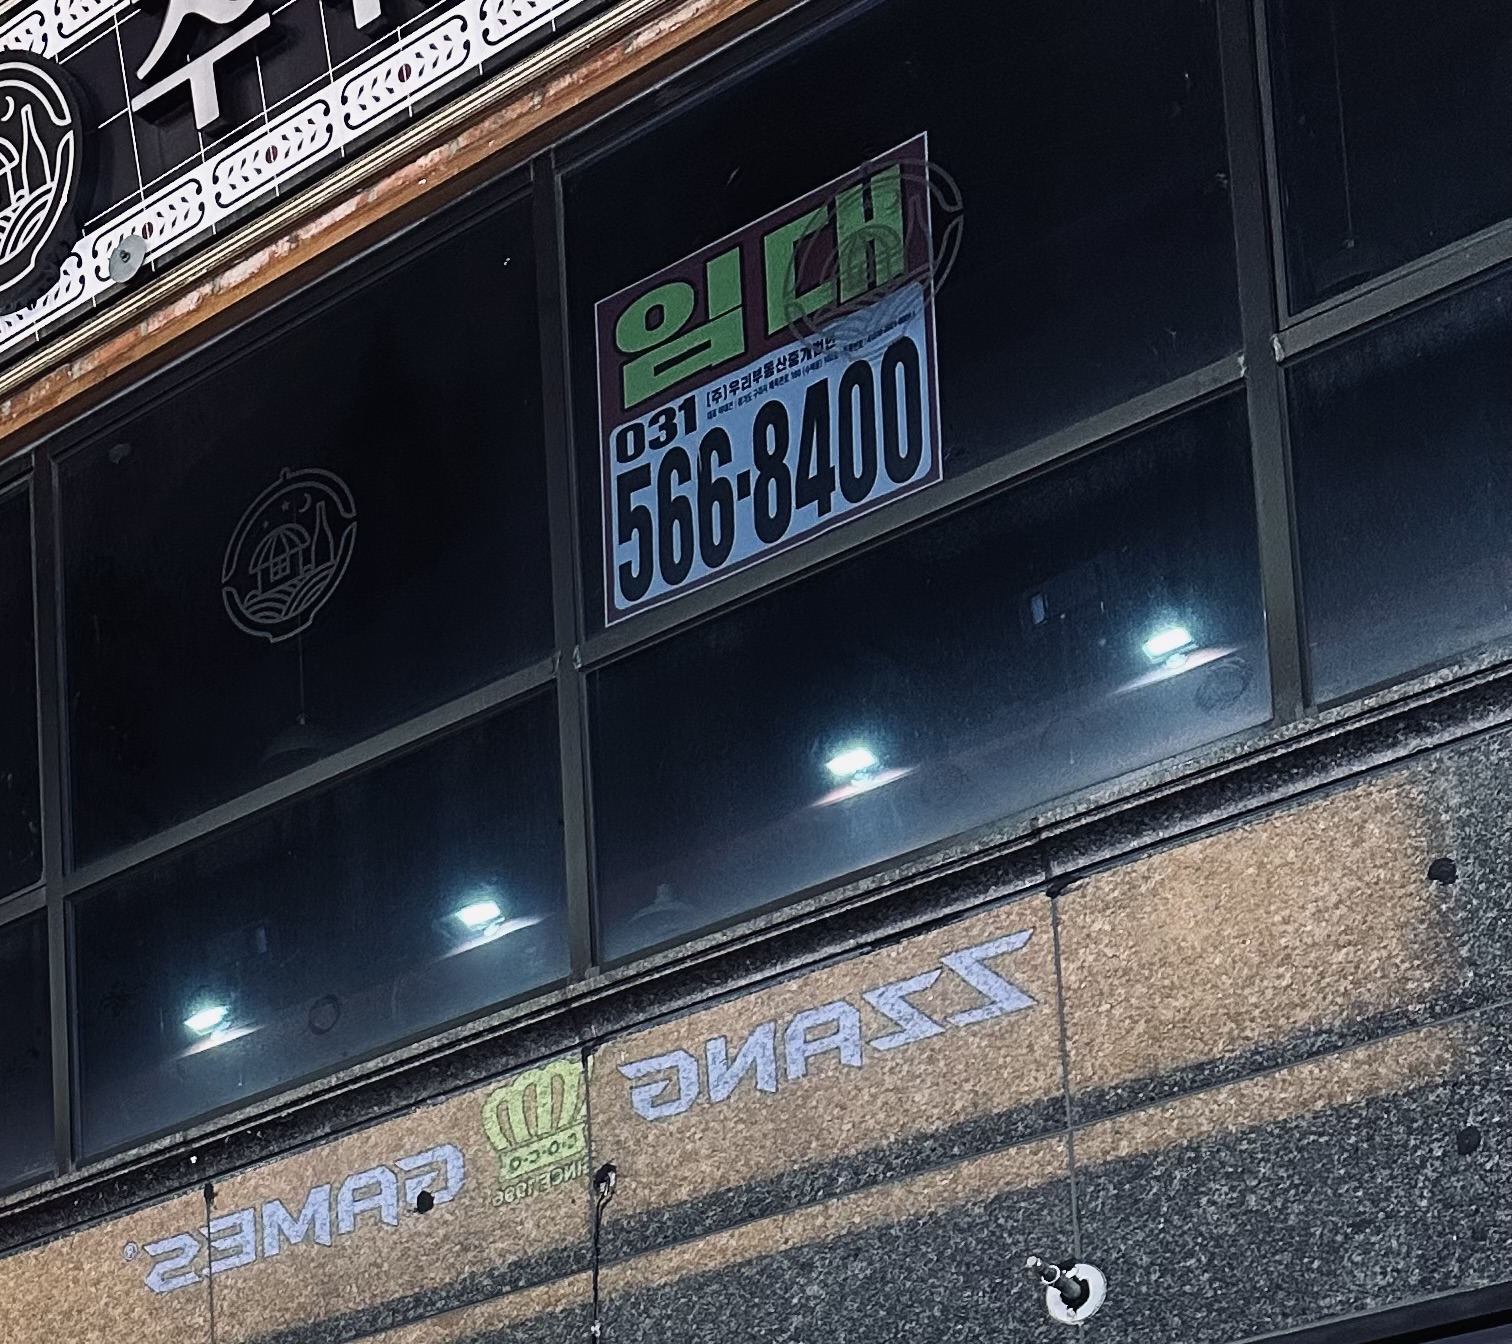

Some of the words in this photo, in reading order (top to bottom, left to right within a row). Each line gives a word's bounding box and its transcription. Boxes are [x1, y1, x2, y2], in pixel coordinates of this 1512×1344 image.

[615, 164, 905, 409] 임대
[616, 395, 698, 464] 031
[616, 335, 925, 604] 566-8400
